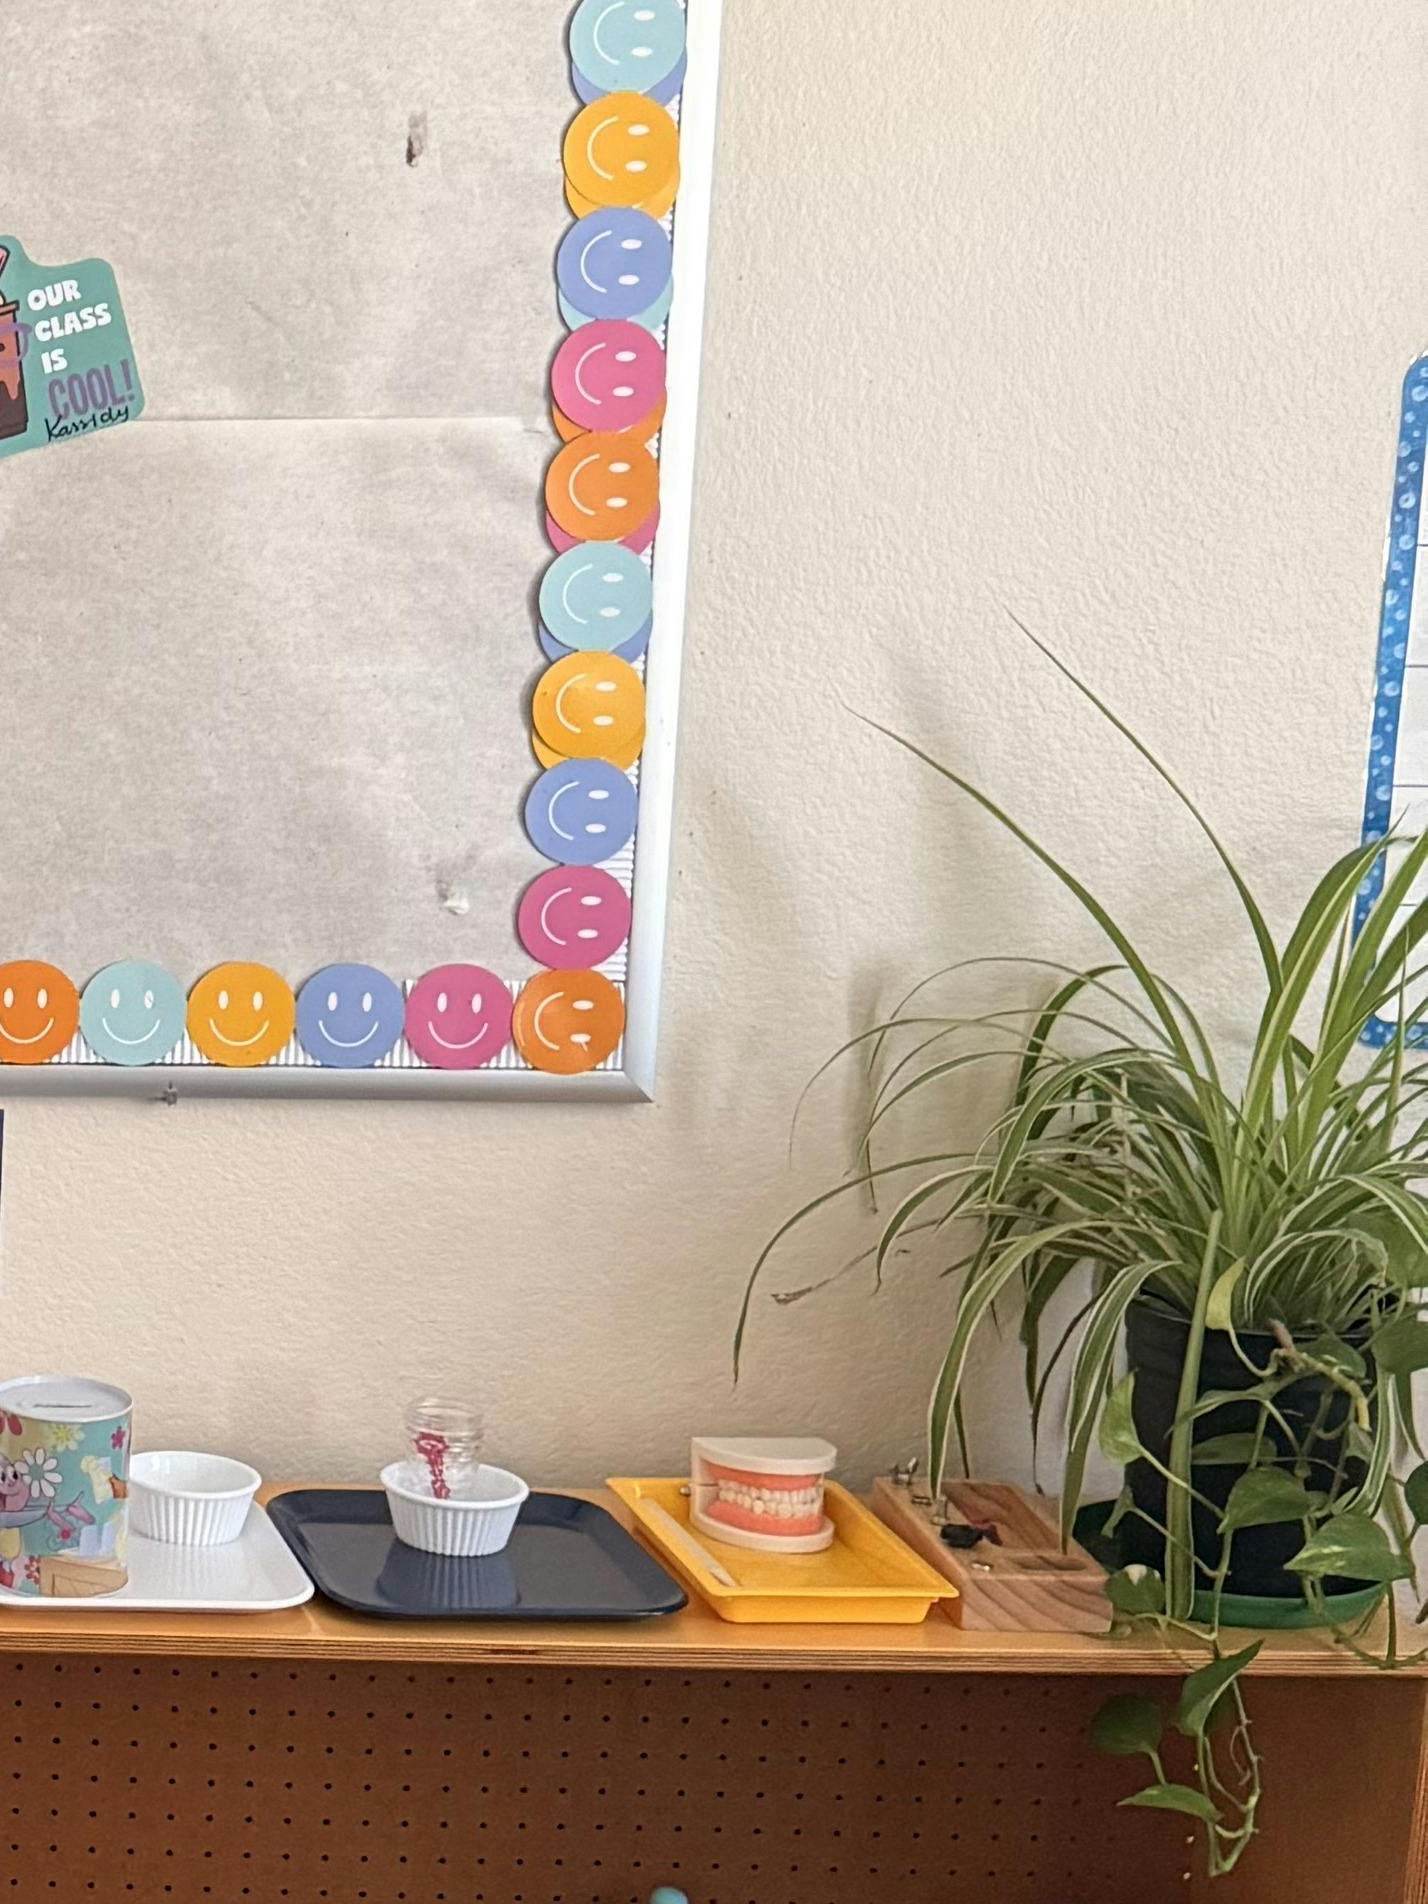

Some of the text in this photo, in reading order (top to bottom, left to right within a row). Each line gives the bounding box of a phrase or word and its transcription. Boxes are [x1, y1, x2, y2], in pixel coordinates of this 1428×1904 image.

[28, 279, 82, 311] OUR
[35, 303, 112, 342] CLASS
[41, 348, 68, 374] IS
[48, 358, 135, 420] COOL!
